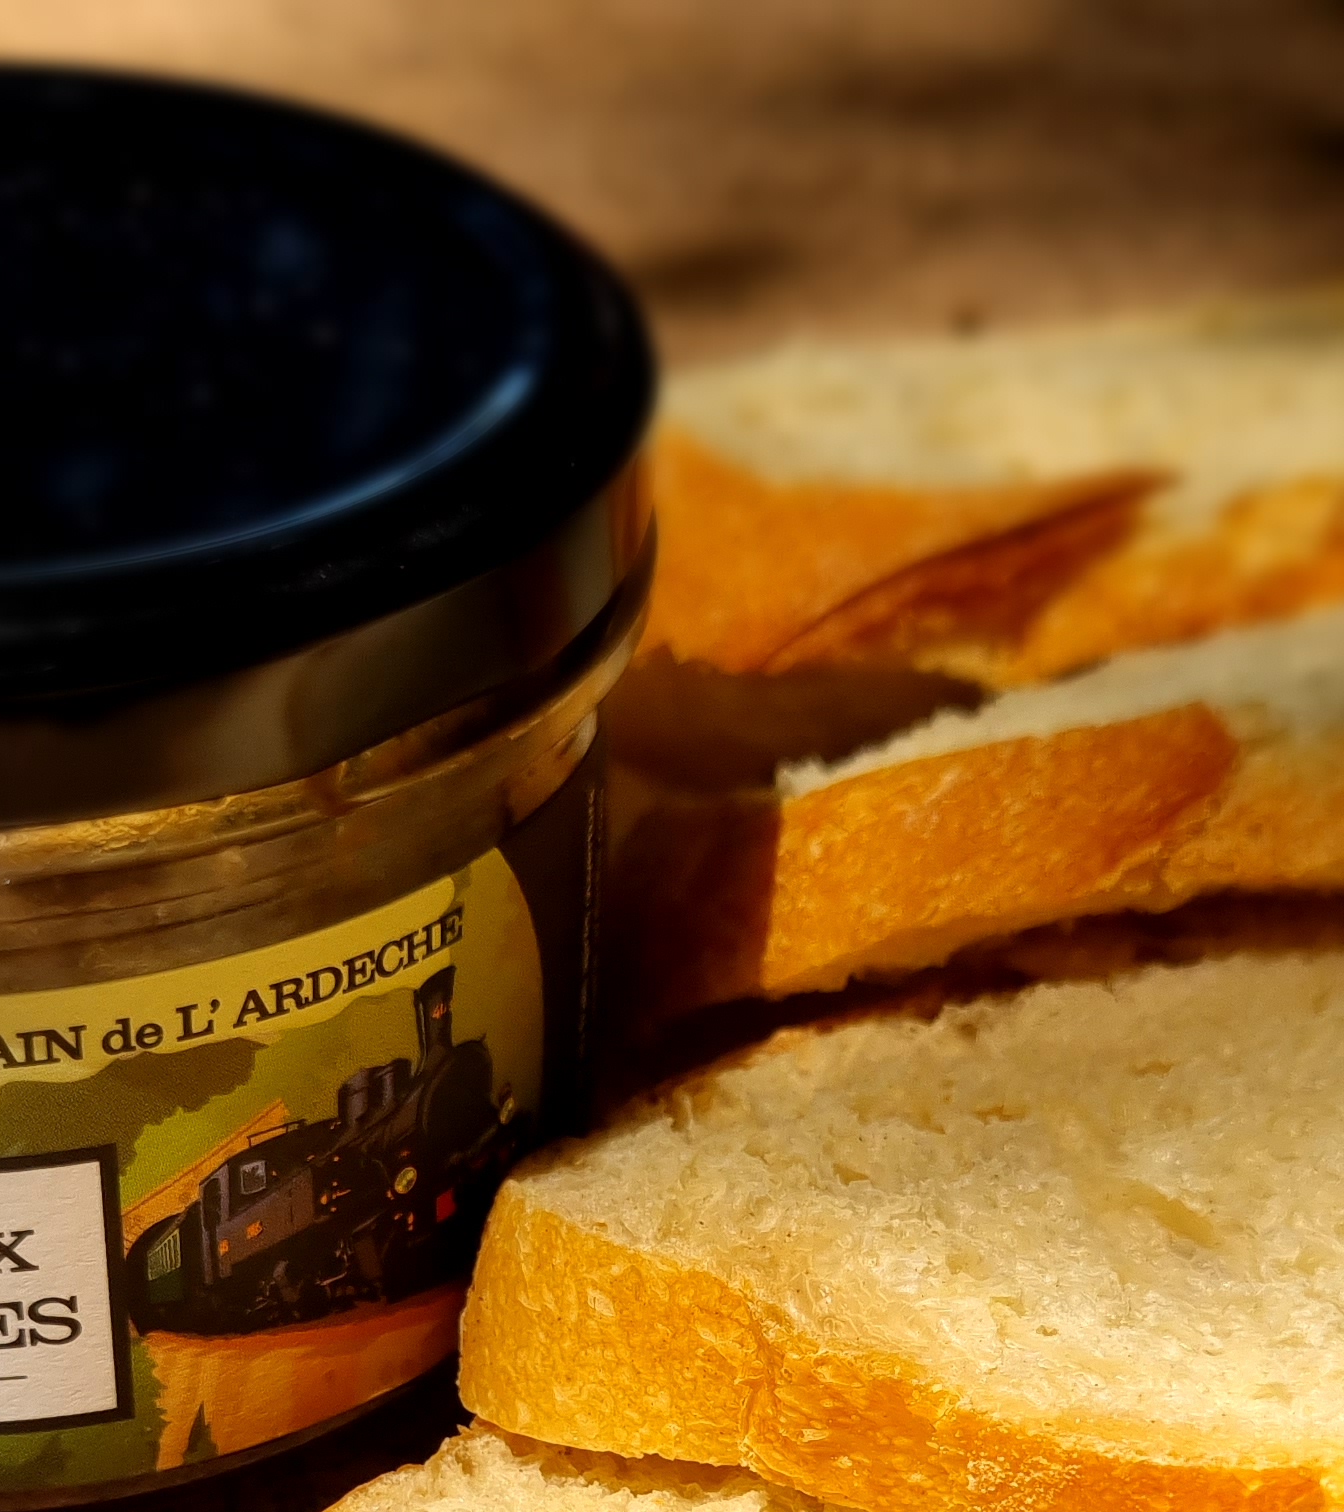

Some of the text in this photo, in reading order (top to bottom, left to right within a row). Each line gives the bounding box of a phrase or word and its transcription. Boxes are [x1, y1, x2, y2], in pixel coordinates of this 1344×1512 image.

[102, 1017, 164, 1055] de
[176, 999, 221, 1042] L'
[233, 905, 464, 1029] ARDECHE
